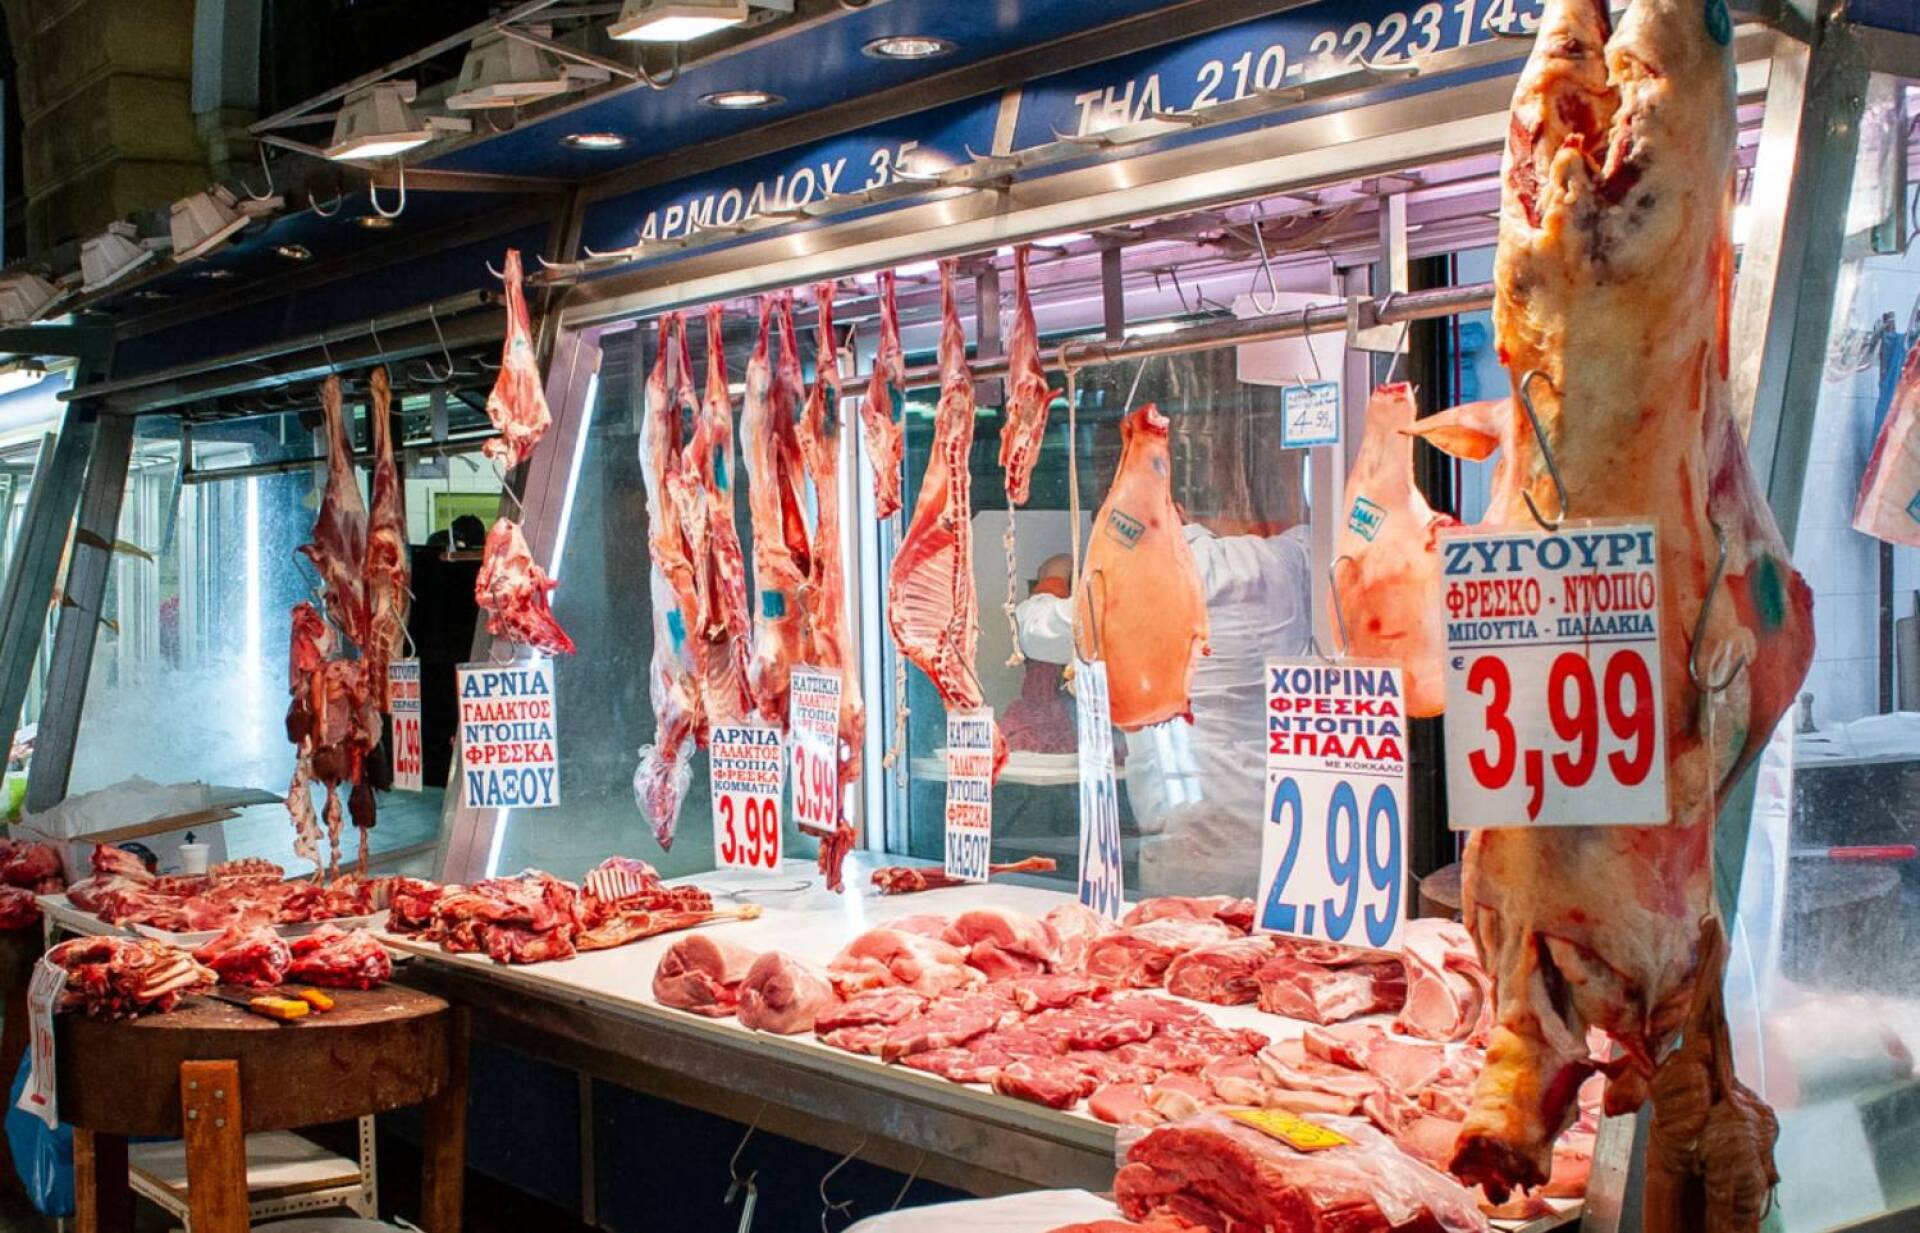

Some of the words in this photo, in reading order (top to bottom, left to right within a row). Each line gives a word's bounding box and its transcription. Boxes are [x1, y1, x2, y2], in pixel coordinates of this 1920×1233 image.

[1074, 73, 1175, 137] ΤΗΛ.
[865, 140, 919, 191] 35
[1444, 531, 1655, 576] ΖΥΓΟΥΡΙ
[1446, 577, 1541, 619] ΦΡΕΣΚΟ
[1563, 571, 1656, 614] ΝΤΟΠΙΟ
[1447, 620, 1538, 642] ΜΠΟΥΤΙΑ
[1557, 614, 1655, 637] ΠΑΙΔΑΚΙΑ
[462, 671, 549, 698] ΑΡΝΙΑ
[1270, 668, 1399, 697] ΧΟΙΡΙΝΑ
[463, 700, 551, 722] ΓΑΛΑΚΤΟΣ
[795, 706, 837, 723] ΤΟΠΙΑ
[1269, 697, 1400, 718] ΦΡΕΣΚΑ
[465, 722, 552, 744] ΝΤΟΠΙΑ
[713, 728, 779, 745] ΑΡΝΙΑ
[1269, 716, 1402, 737] ΝΤΟΠΙΑ
[1466, 649, 1656, 822] 3,99
[466, 743, 554, 765] ΦΡΕΣΚΑ
[713, 745, 779, 760] ΓΑΛΑΚΤΟΣ
[1269, 732, 1404, 762] ΣΠΑΛΑ
[713, 758, 779, 772] ΝΤΟΠΙΑ
[714, 768, 779, 783] ΦΡΕΣΚΑ
[1325, 760, 1341, 769] ΜΕ
[1344, 761, 1404, 773] ΚΟΚΚΑΛΟ
[467, 768, 555, 807] ΝΑΞΟΥ
[714, 780, 779, 795] ΚΟΜΜΑΤΙΑ
[795, 745, 835, 825] 3.99
[719, 795, 779, 869] 3.99
[948, 832, 989, 880] ΝΑΞΟΥ
[1261, 776, 1402, 948] 2.99
